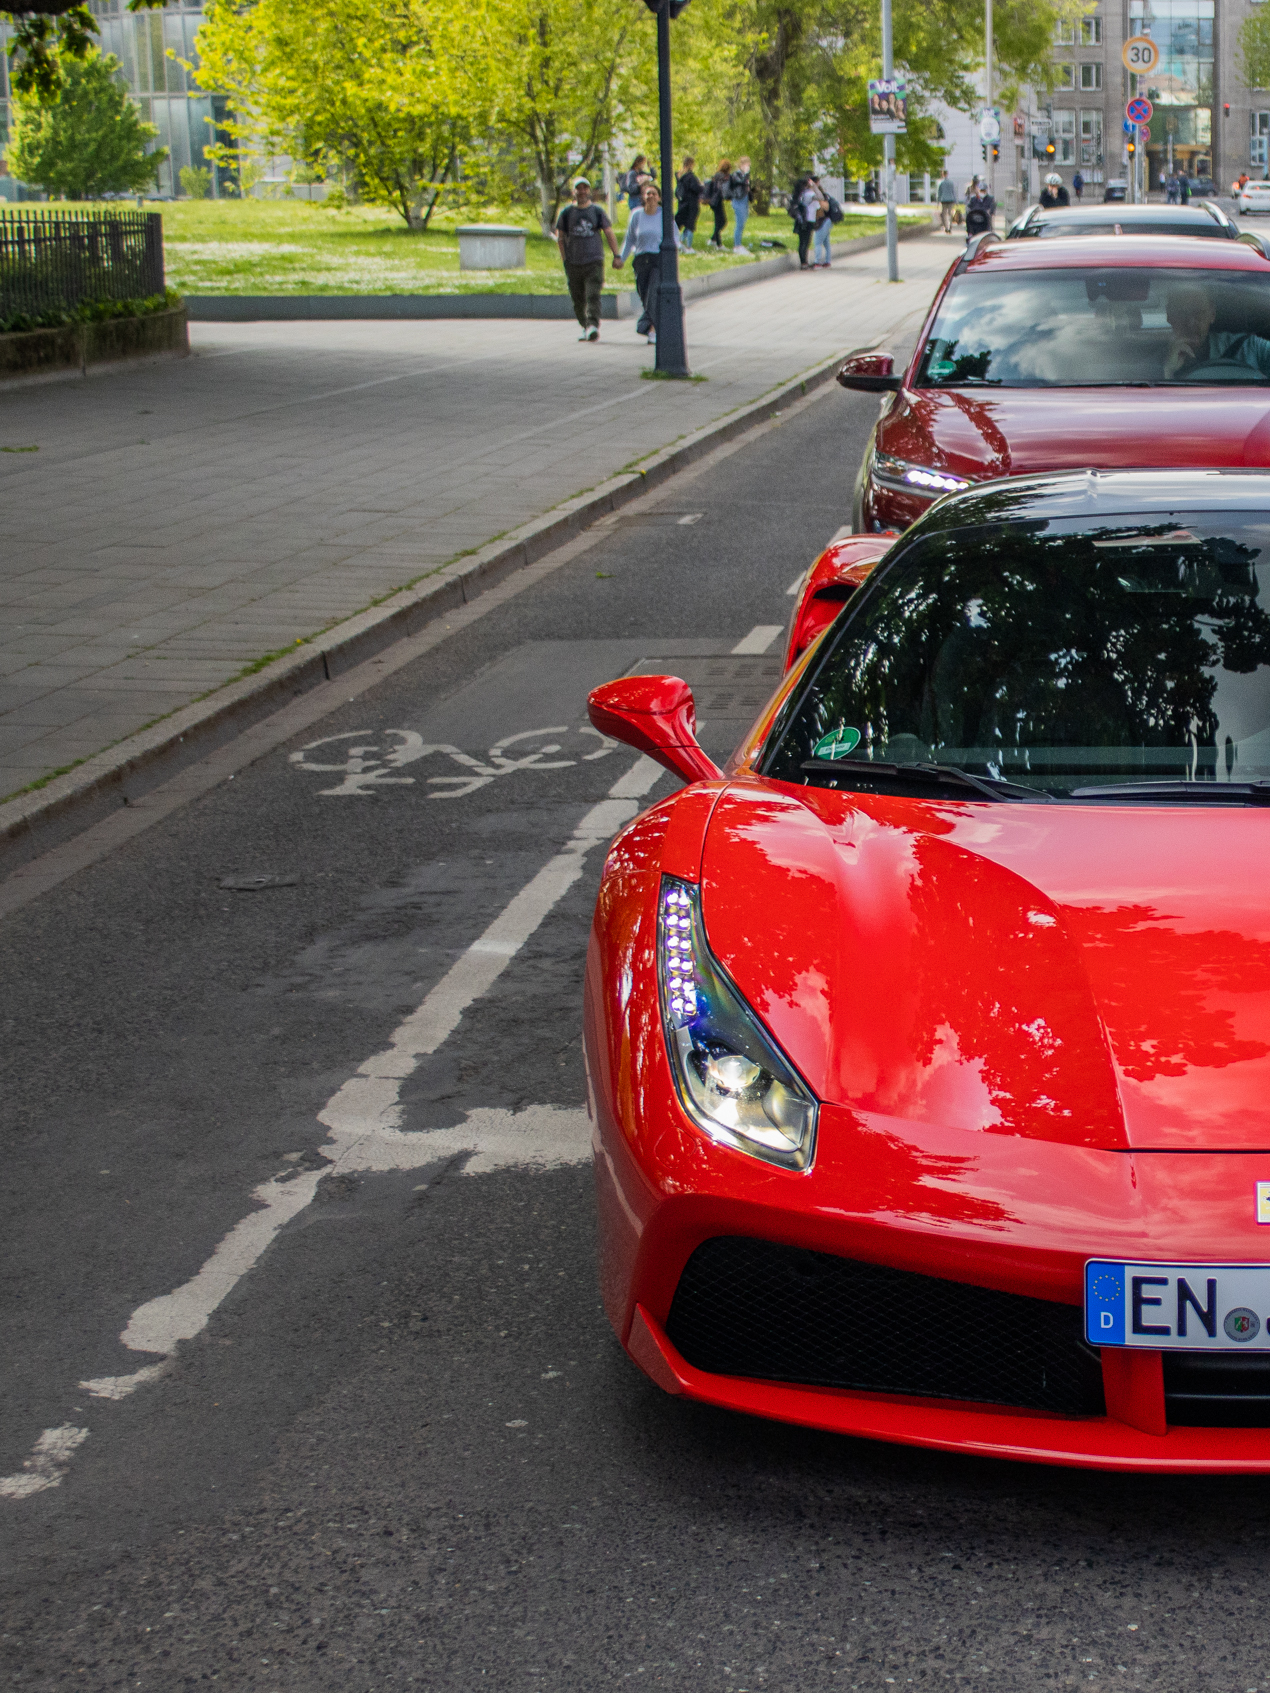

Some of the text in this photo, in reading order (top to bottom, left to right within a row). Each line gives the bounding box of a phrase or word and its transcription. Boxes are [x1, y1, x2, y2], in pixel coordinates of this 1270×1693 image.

[1130, 46, 1152, 64] 30
[876, 80, 900, 93] Volt
[1131, 1275, 1218, 1339] EN
[1099, 1310, 1115, 1330] D
